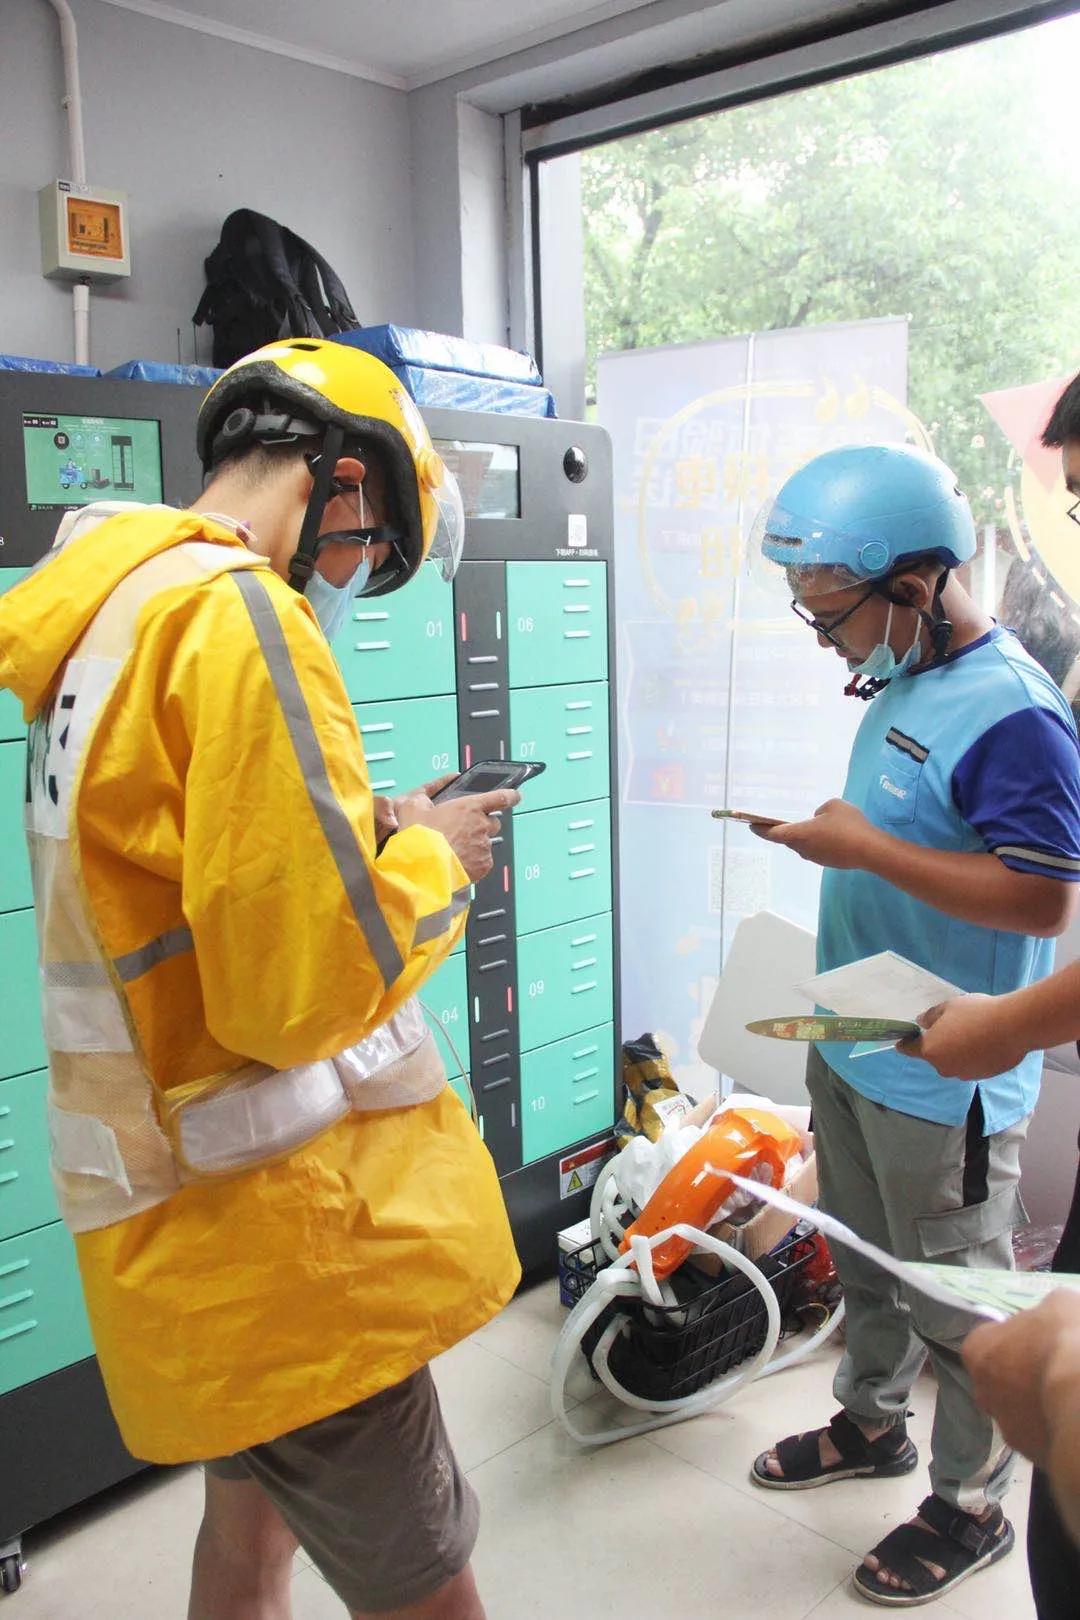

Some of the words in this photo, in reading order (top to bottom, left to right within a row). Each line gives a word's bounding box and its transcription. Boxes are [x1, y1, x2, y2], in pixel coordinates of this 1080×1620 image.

[426, 621, 443, 638] 01
[517, 617, 534, 633] 06
[520, 741, 536, 757] 07
[432, 753, 449, 770] 02
[525, 864, 541, 881] 08
[529, 980, 544, 997] 09
[442, 1007, 458, 1024] 04
[531, 1096, 545, 1111] 10
